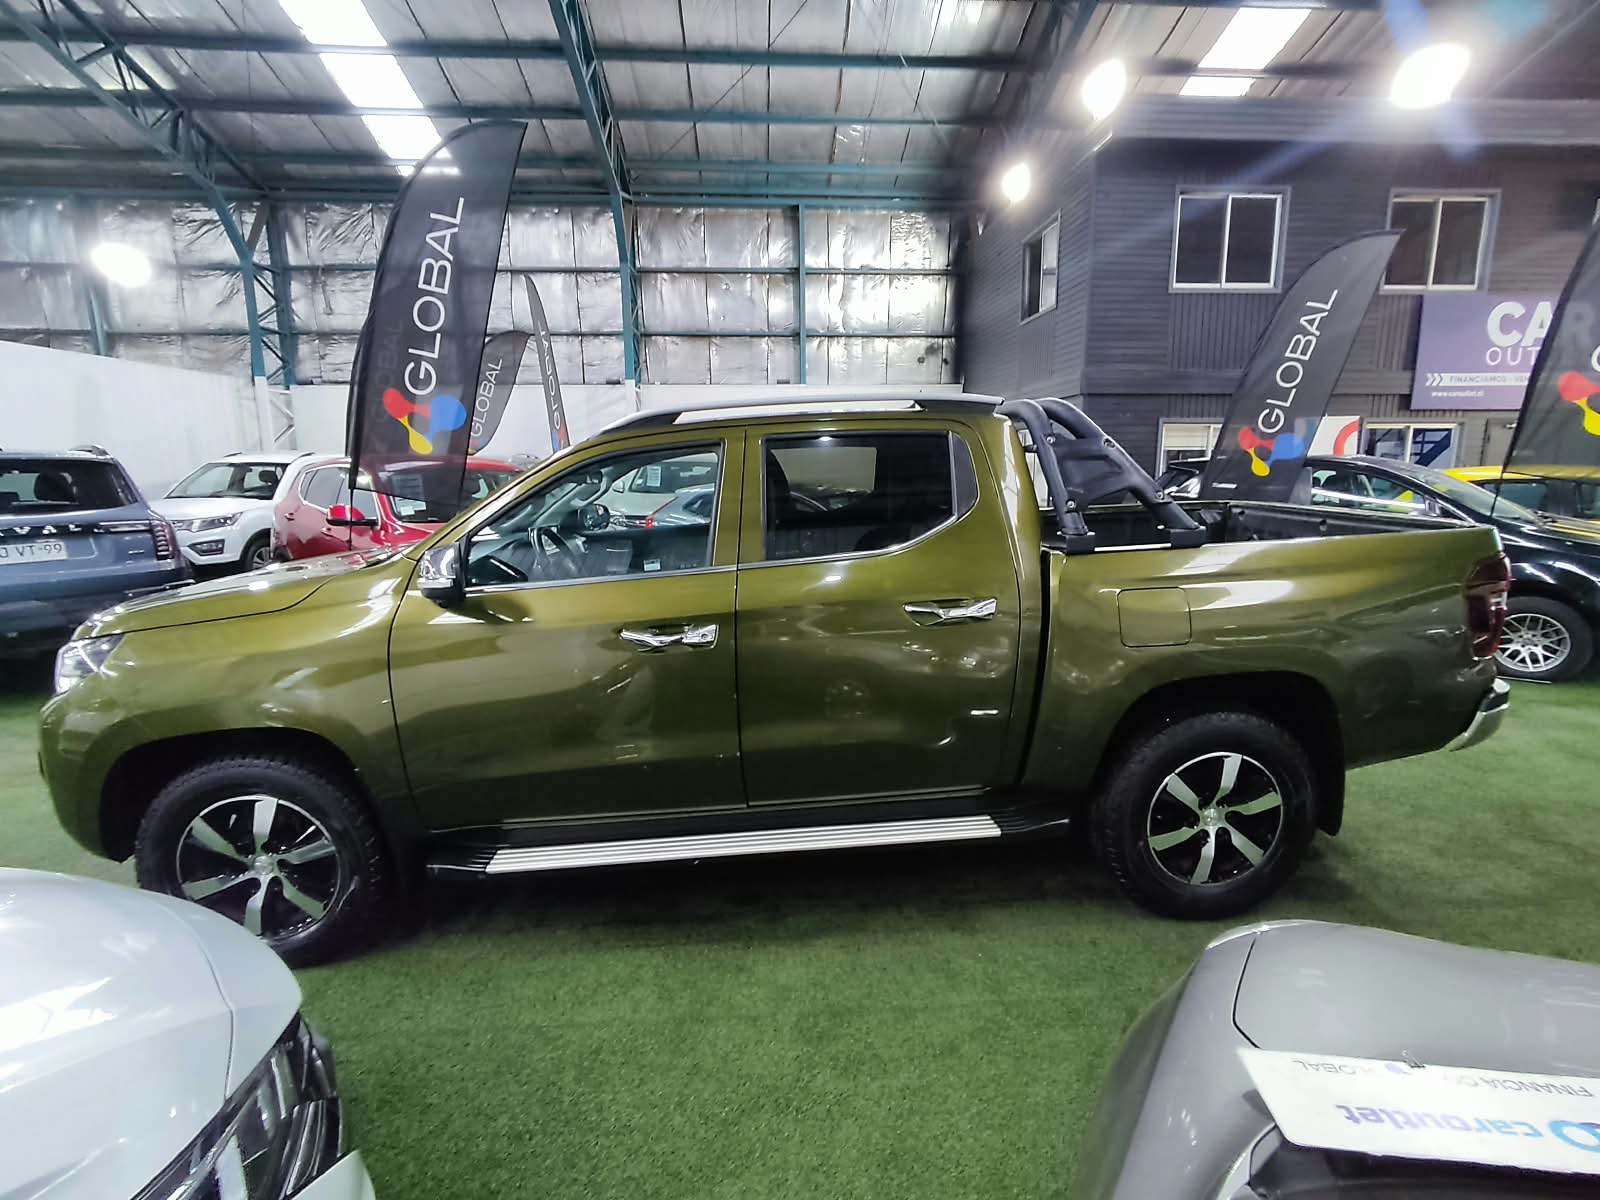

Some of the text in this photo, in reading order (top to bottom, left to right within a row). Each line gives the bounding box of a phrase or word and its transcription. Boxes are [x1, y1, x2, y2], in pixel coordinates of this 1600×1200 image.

[404, 197, 464, 395] GLOBAL
[1257, 289, 1338, 433] GLOBAL
[1486, 346, 1541, 366] OUT
[470, 358, 503, 438] GLOBAL
[1480, 1076, 1594, 1098] FINANCIA
